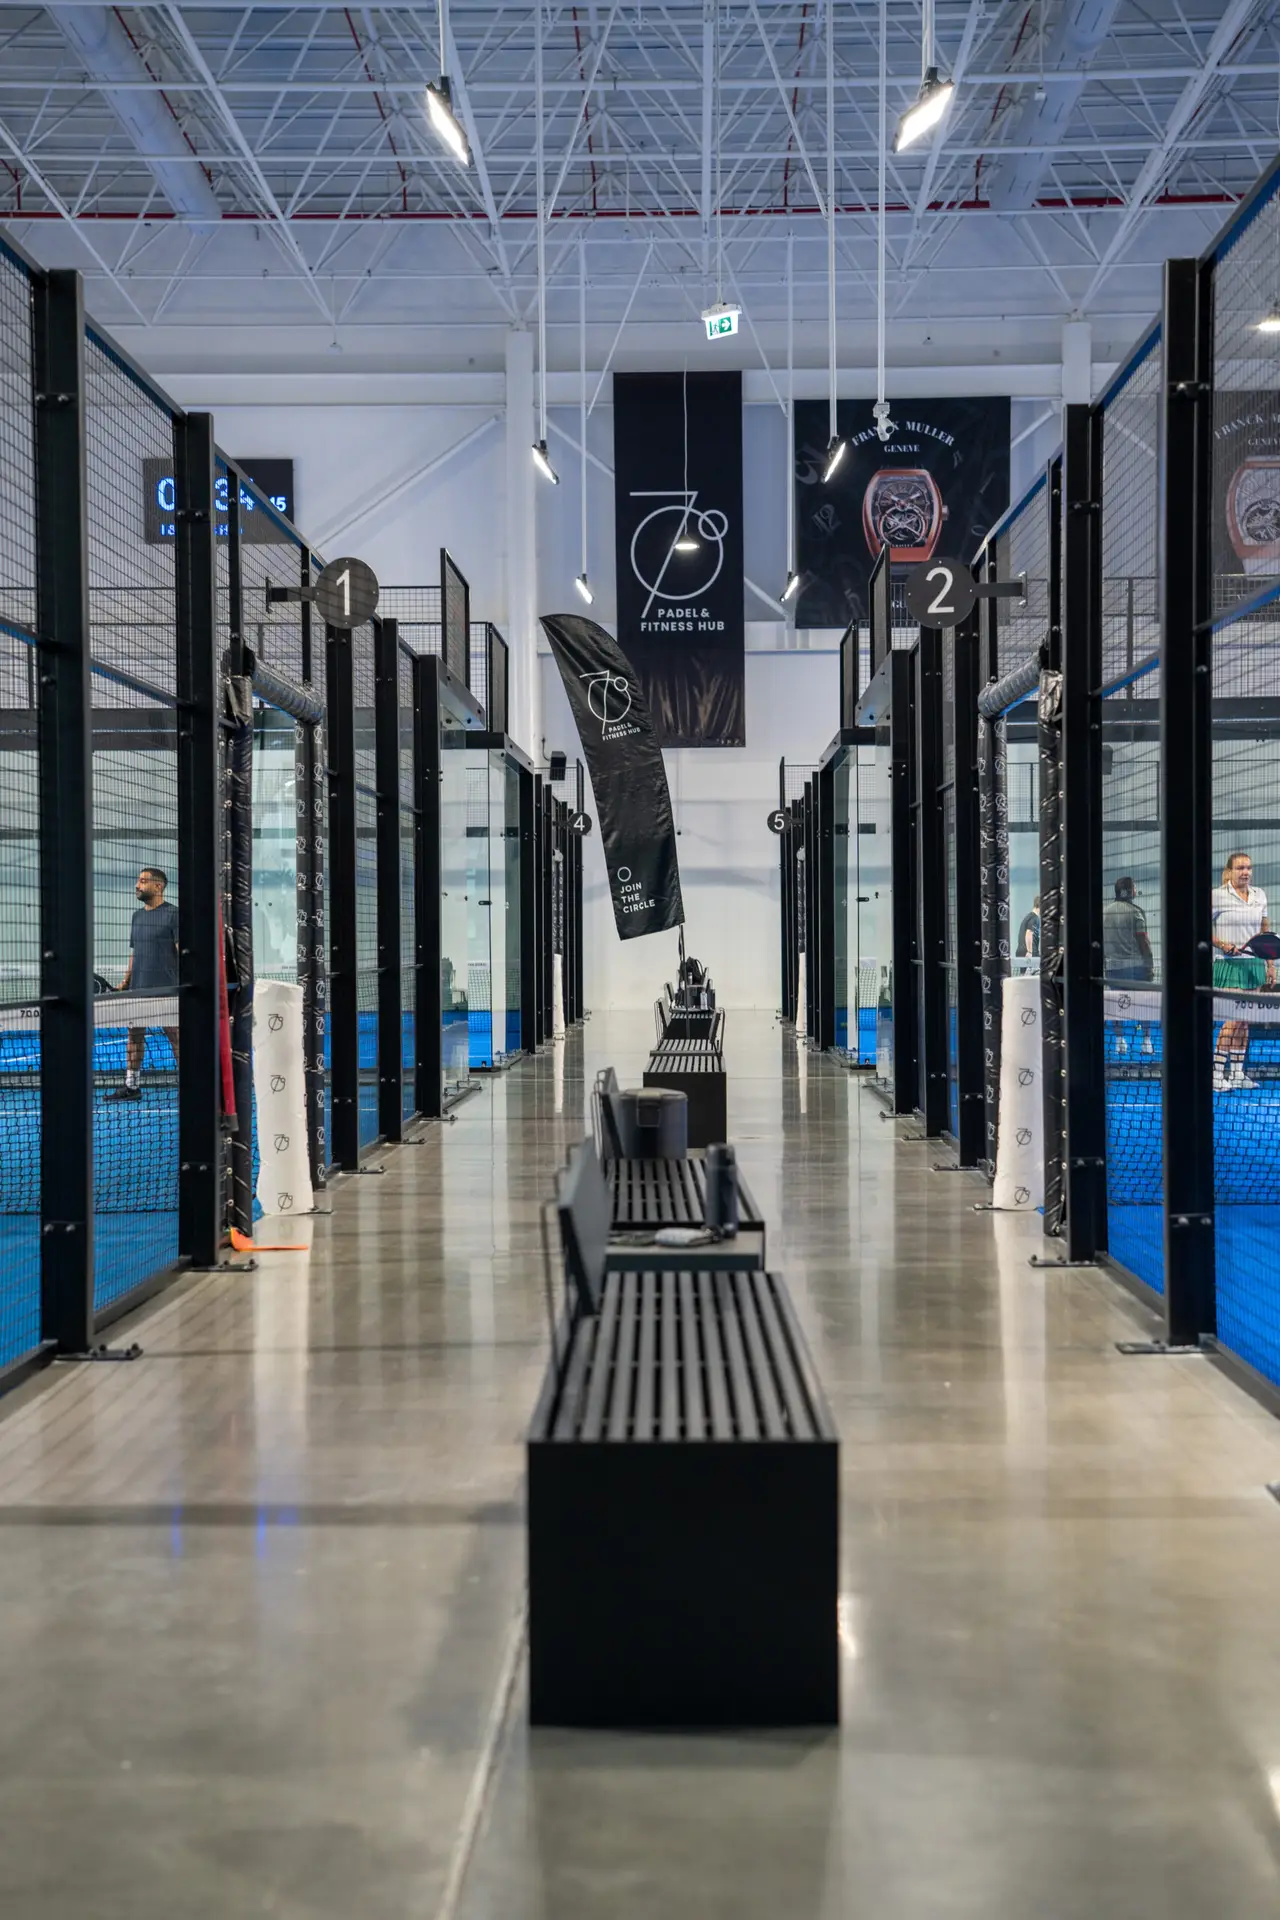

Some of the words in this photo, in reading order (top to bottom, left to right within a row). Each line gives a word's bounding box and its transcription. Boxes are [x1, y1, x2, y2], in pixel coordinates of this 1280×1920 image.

[851, 421, 900, 447] FRANK
[905, 421, 956, 447] MULLER
[884, 444, 920, 453] GENEVE
[336, 569, 350, 616] 1
[925, 567, 955, 614] 2
[640, 621, 694, 632] FITNESS
[698, 621, 725, 631] HUB
[602, 731, 627, 741] FITNESS
[627, 726, 641, 735] HUB
[573, 814, 585, 832] 4
[774, 813, 785, 830] 5
[620, 881, 642, 894] JOIN
[621, 893, 640, 903] THE
[623, 899, 656, 914] CIRCLE
